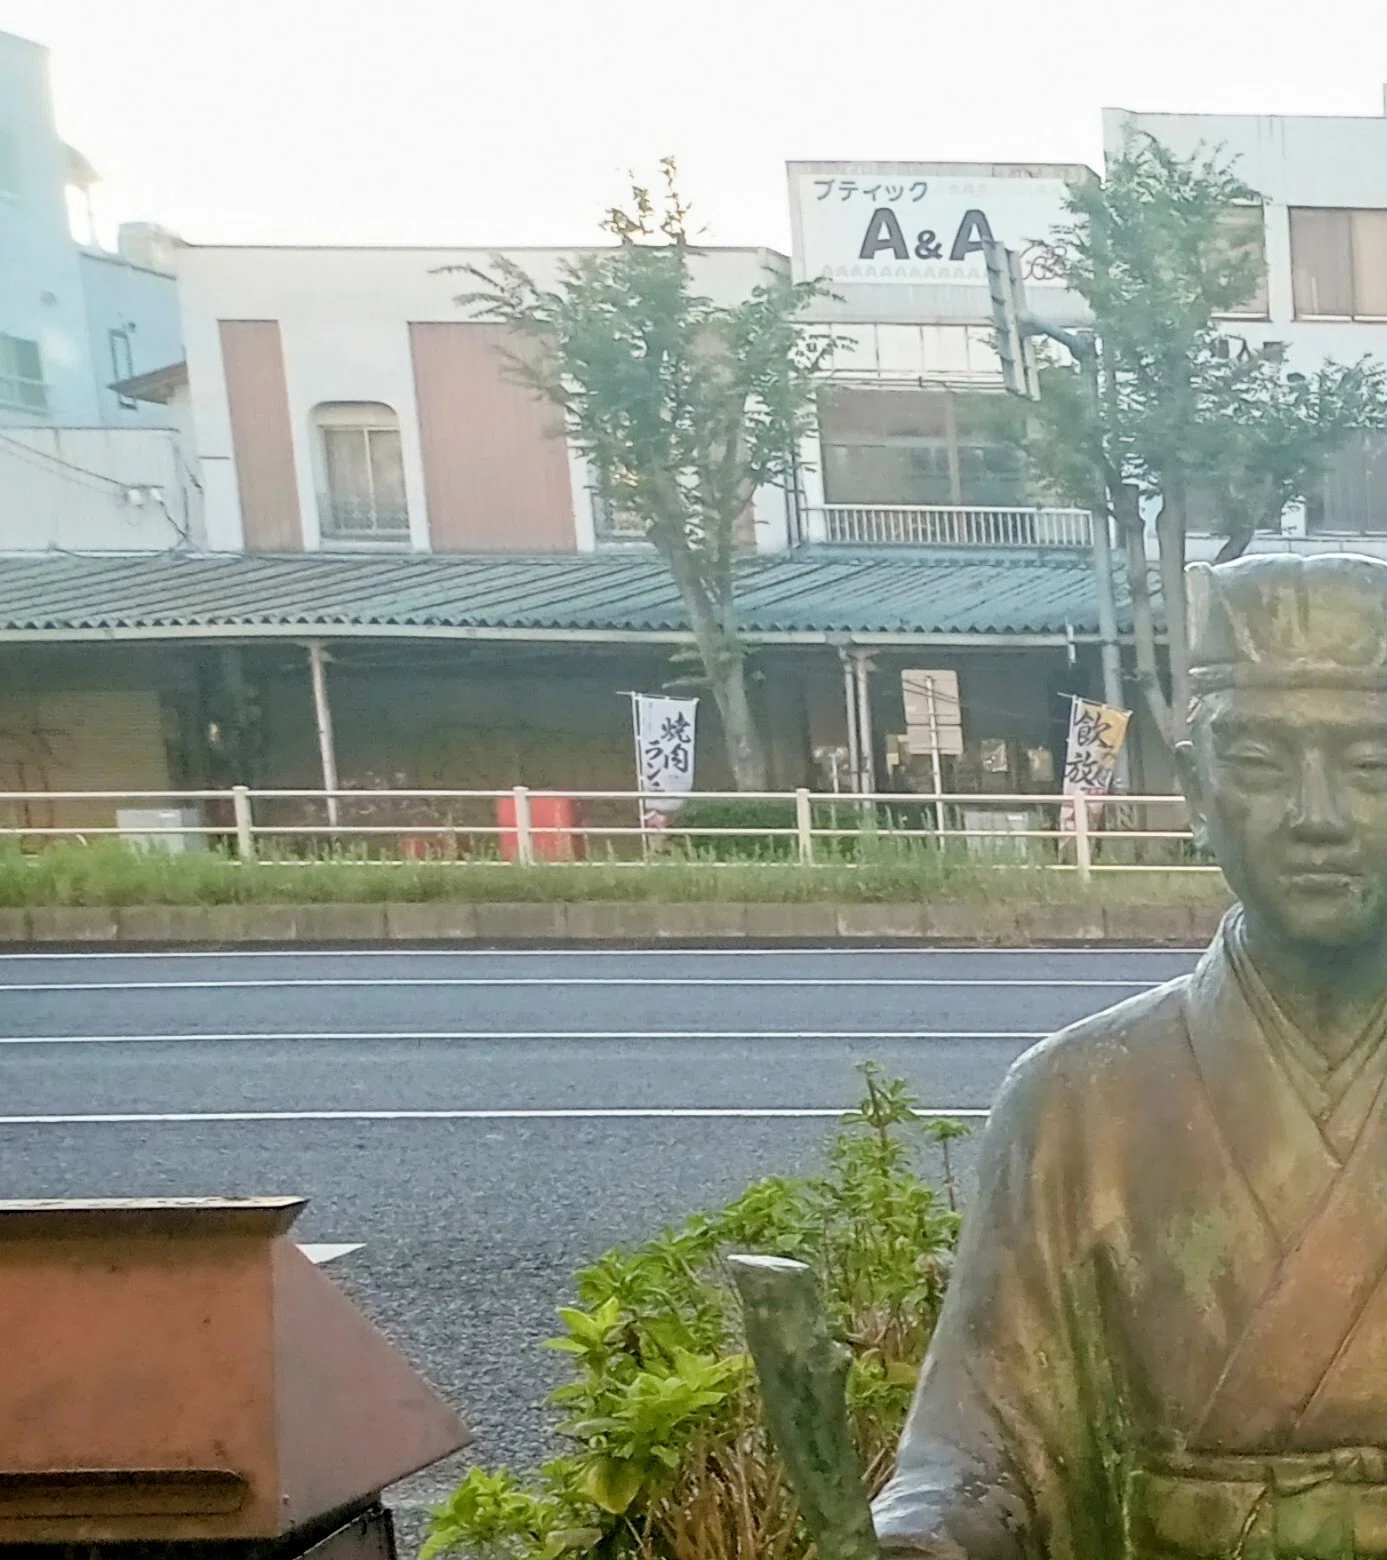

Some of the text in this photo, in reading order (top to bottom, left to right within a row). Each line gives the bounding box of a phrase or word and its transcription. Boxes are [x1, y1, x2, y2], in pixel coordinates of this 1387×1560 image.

[813, 179, 928, 203] ブティック
[859, 207, 995, 261] A&A
[661, 711, 692, 773] 焼肉
